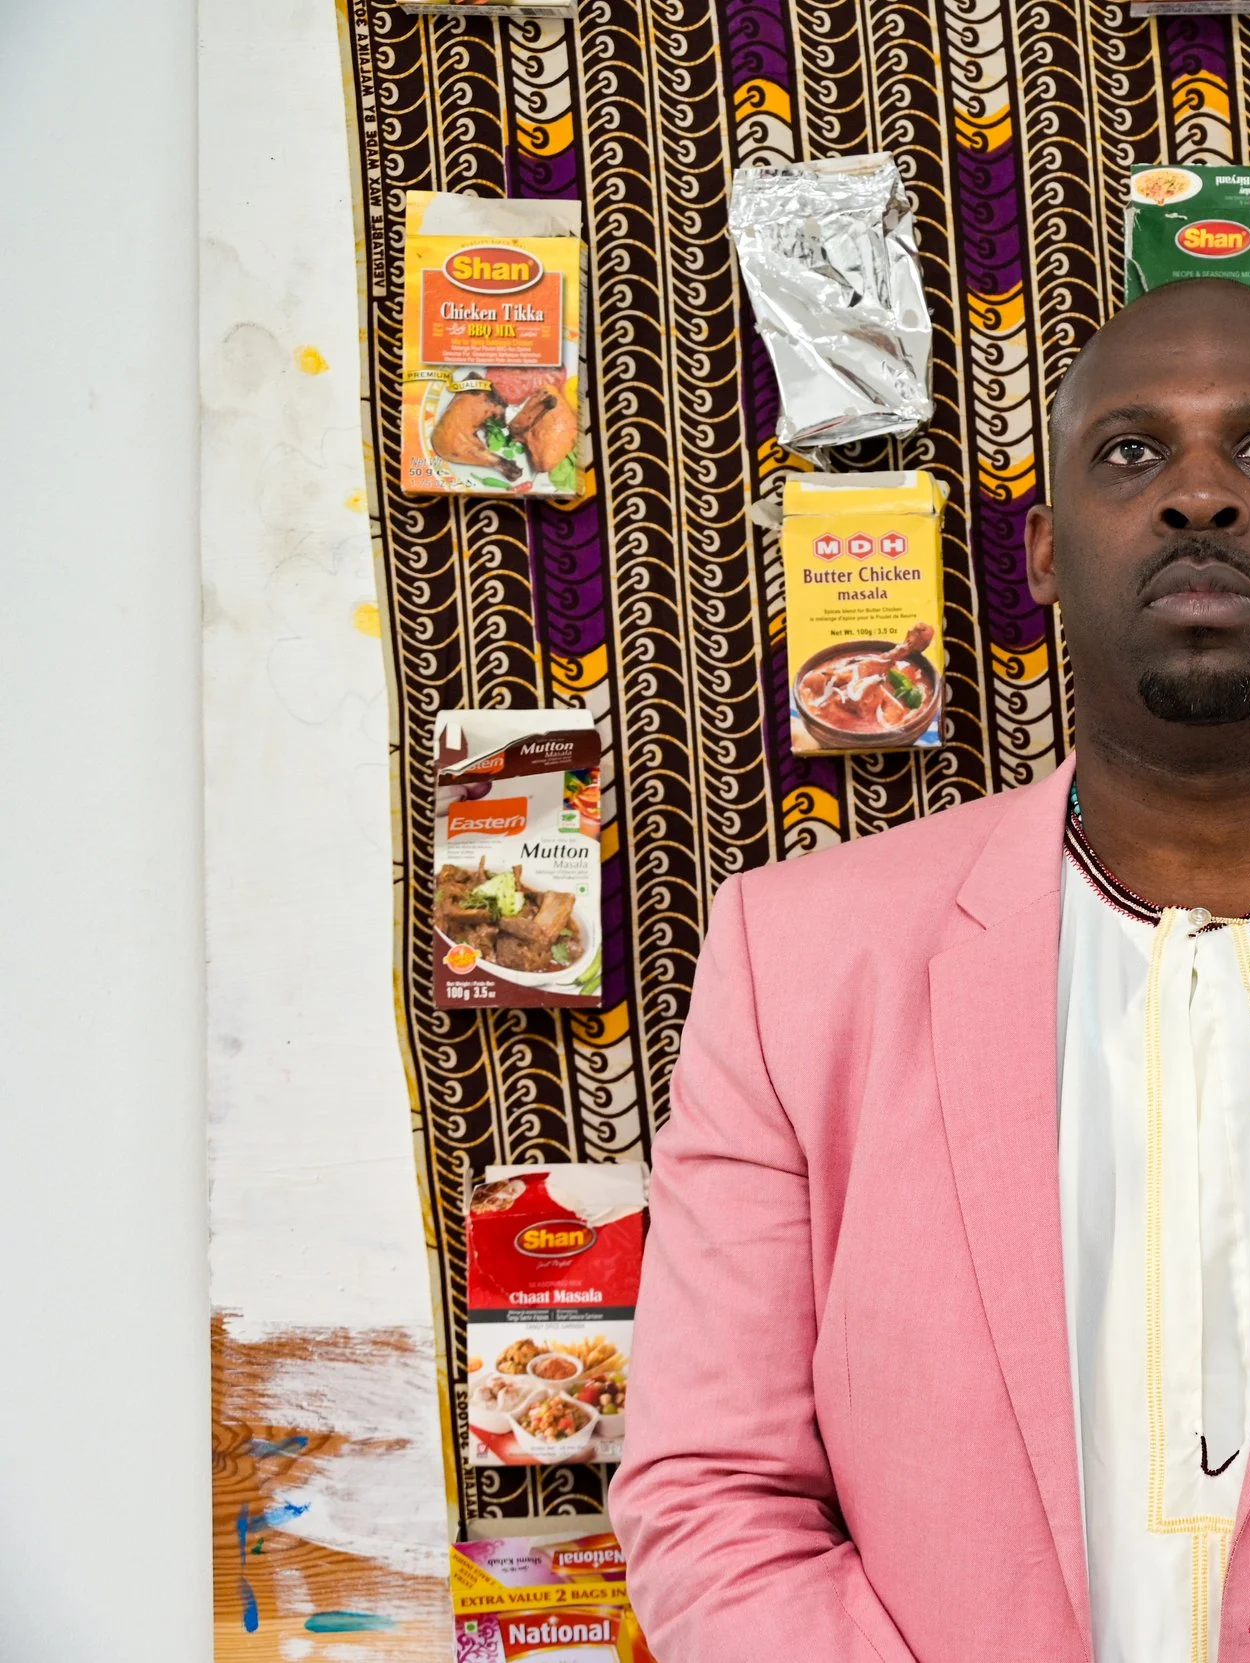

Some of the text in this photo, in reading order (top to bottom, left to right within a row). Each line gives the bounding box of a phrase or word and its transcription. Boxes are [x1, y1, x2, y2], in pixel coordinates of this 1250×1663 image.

[1215, 174, 1250, 186] Biryani
[1184, 228, 1243, 248] Shan
[452, 255, 530, 281] Shan
[440, 301, 544, 321] Chicken Tikka
[468, 323, 492, 339] BBQ
[494, 323, 516, 337] MIX
[407, 371, 450, 380] PREMIUM
[453, 381, 490, 390] QUALITY
[409, 468, 422, 476] 50
[815, 535, 906, 558] MDH
[803, 566, 921, 584] Butter Chicken
[838, 587, 888, 601] masala
[520, 742, 574, 756] Mutton
[449, 814, 525, 831] Eastern
[520, 843, 589, 859] Mutton
[553, 860, 588, 869] Masala
[523, 1229, 584, 1250] Shan
[509, 1287, 603, 1304] Chaat Masala
[461, 1596, 505, 1608] EXTRA
[508, 1592, 550, 1604] VALUE
[555, 1589, 567, 1602] 2
[571, 1587, 607, 1599] BAGS
[508, 1619, 611, 1645] National
